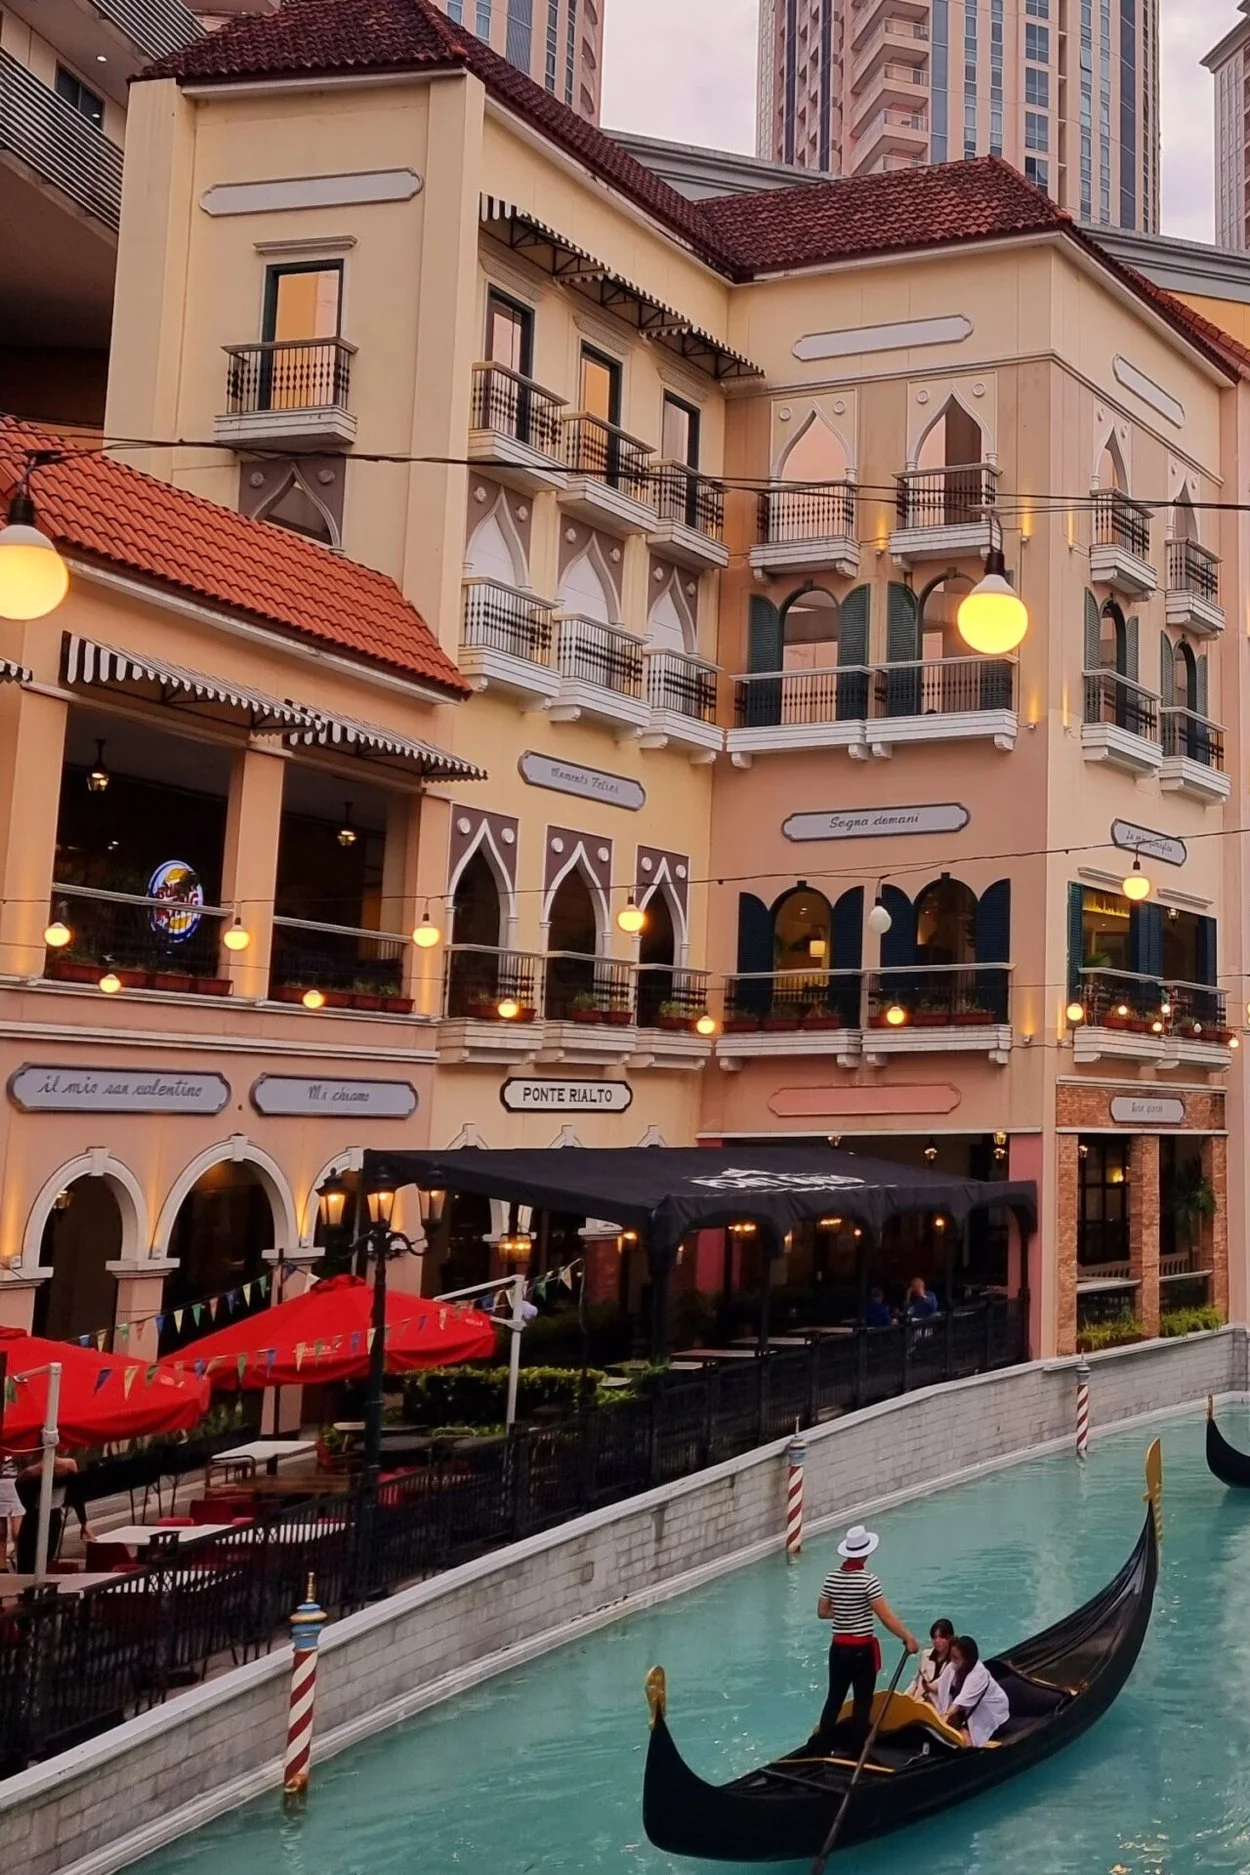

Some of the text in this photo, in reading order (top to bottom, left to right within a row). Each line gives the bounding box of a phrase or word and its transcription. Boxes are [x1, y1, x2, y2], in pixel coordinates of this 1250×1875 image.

[829, 812, 920, 831] Sogna domani
[62, 1077, 98, 1094] mio
[523, 1087, 613, 1103] PONTE RIALTO
